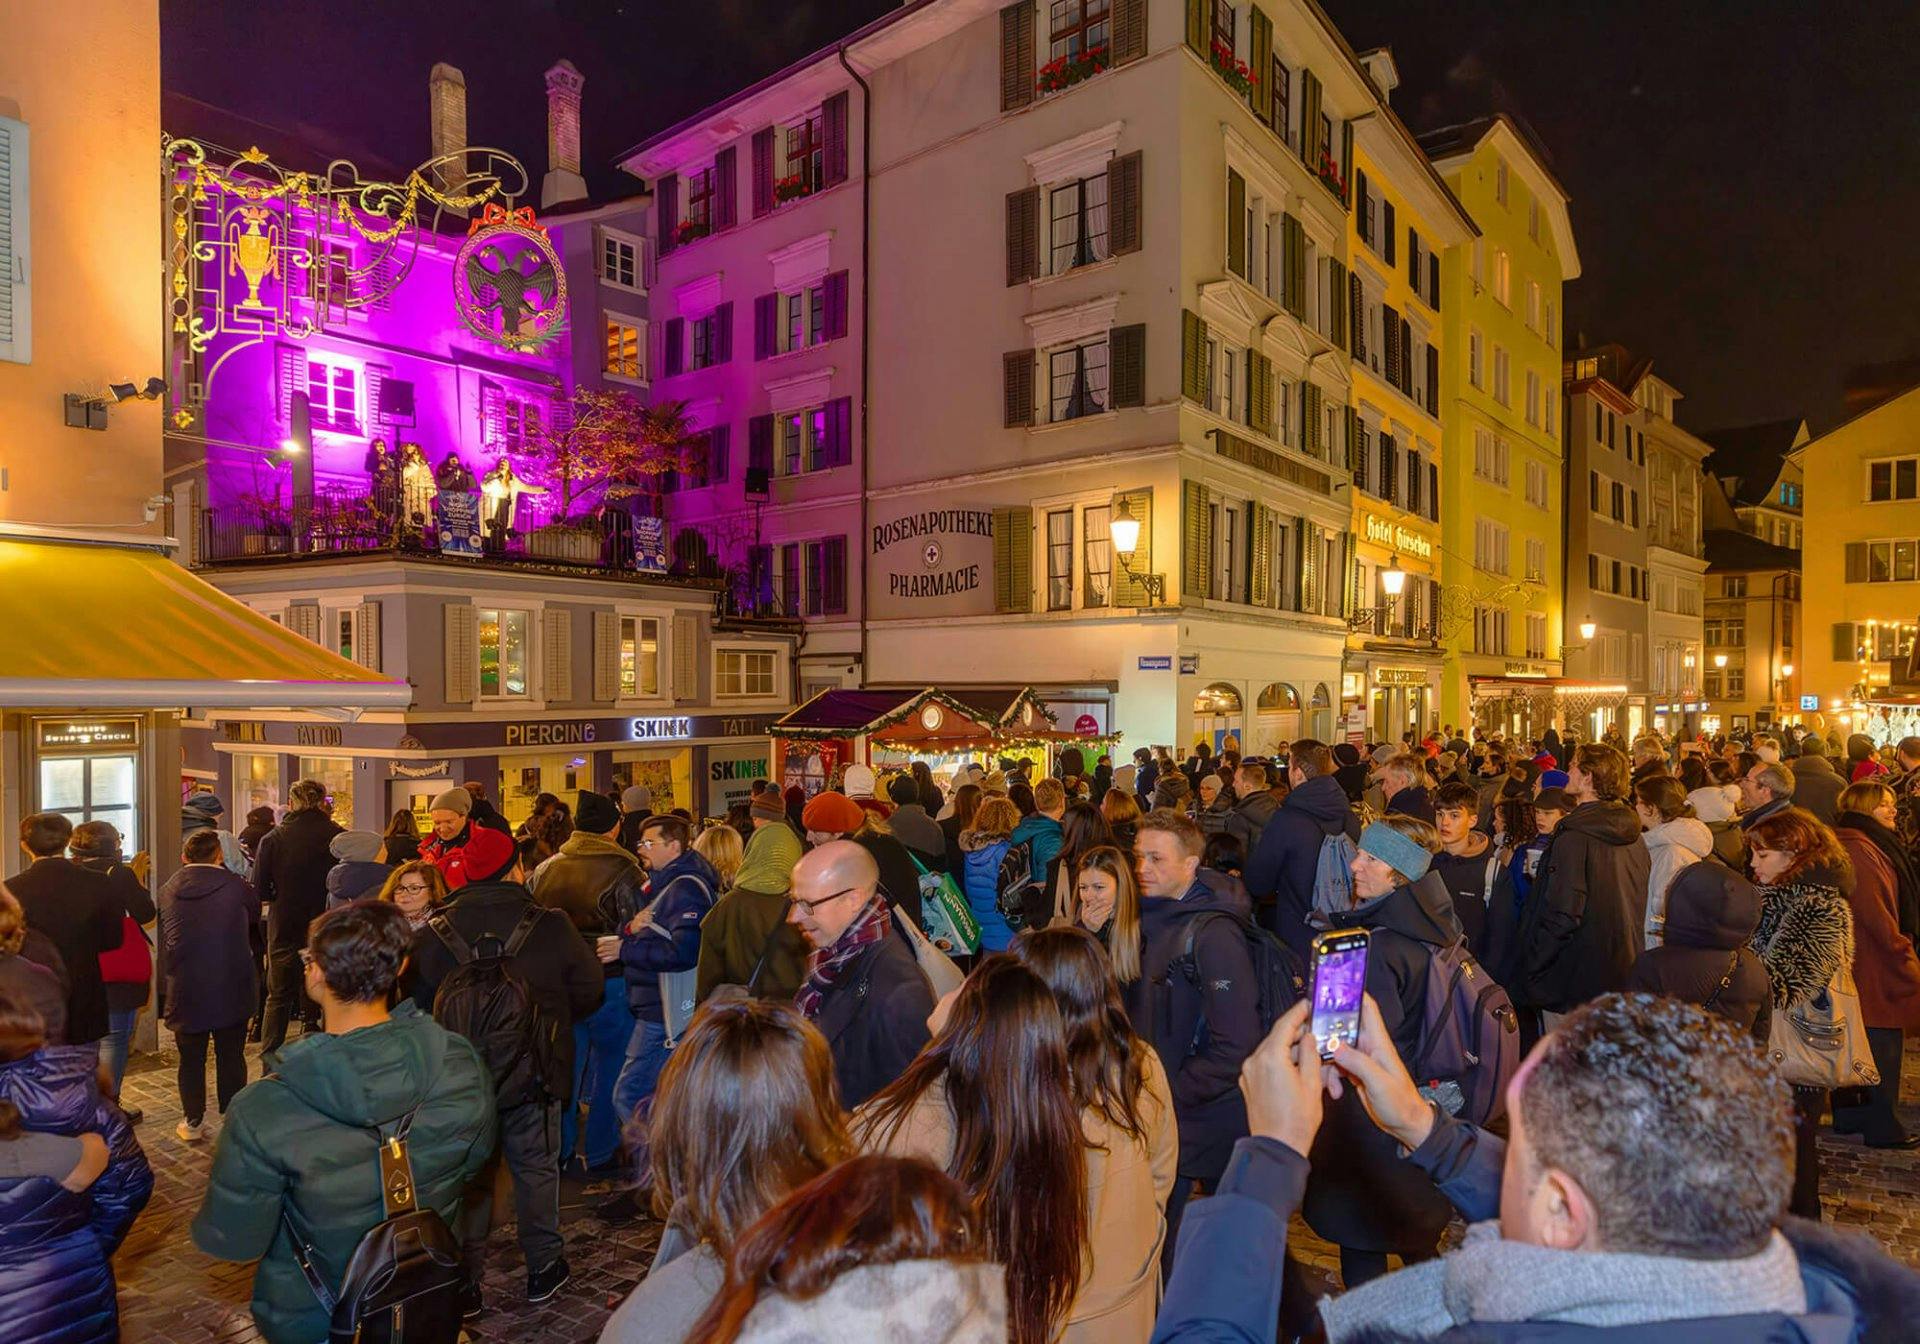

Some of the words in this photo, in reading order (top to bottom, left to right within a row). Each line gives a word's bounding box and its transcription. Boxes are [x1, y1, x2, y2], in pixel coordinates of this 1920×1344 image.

[872, 510, 994, 555] ROSENAPOTHEKE
[889, 564, 980, 598] PHARMACIE
[297, 725, 343, 746] TATTOO
[506, 723, 596, 746] PIERCING
[720, 718, 760, 736] TATT
